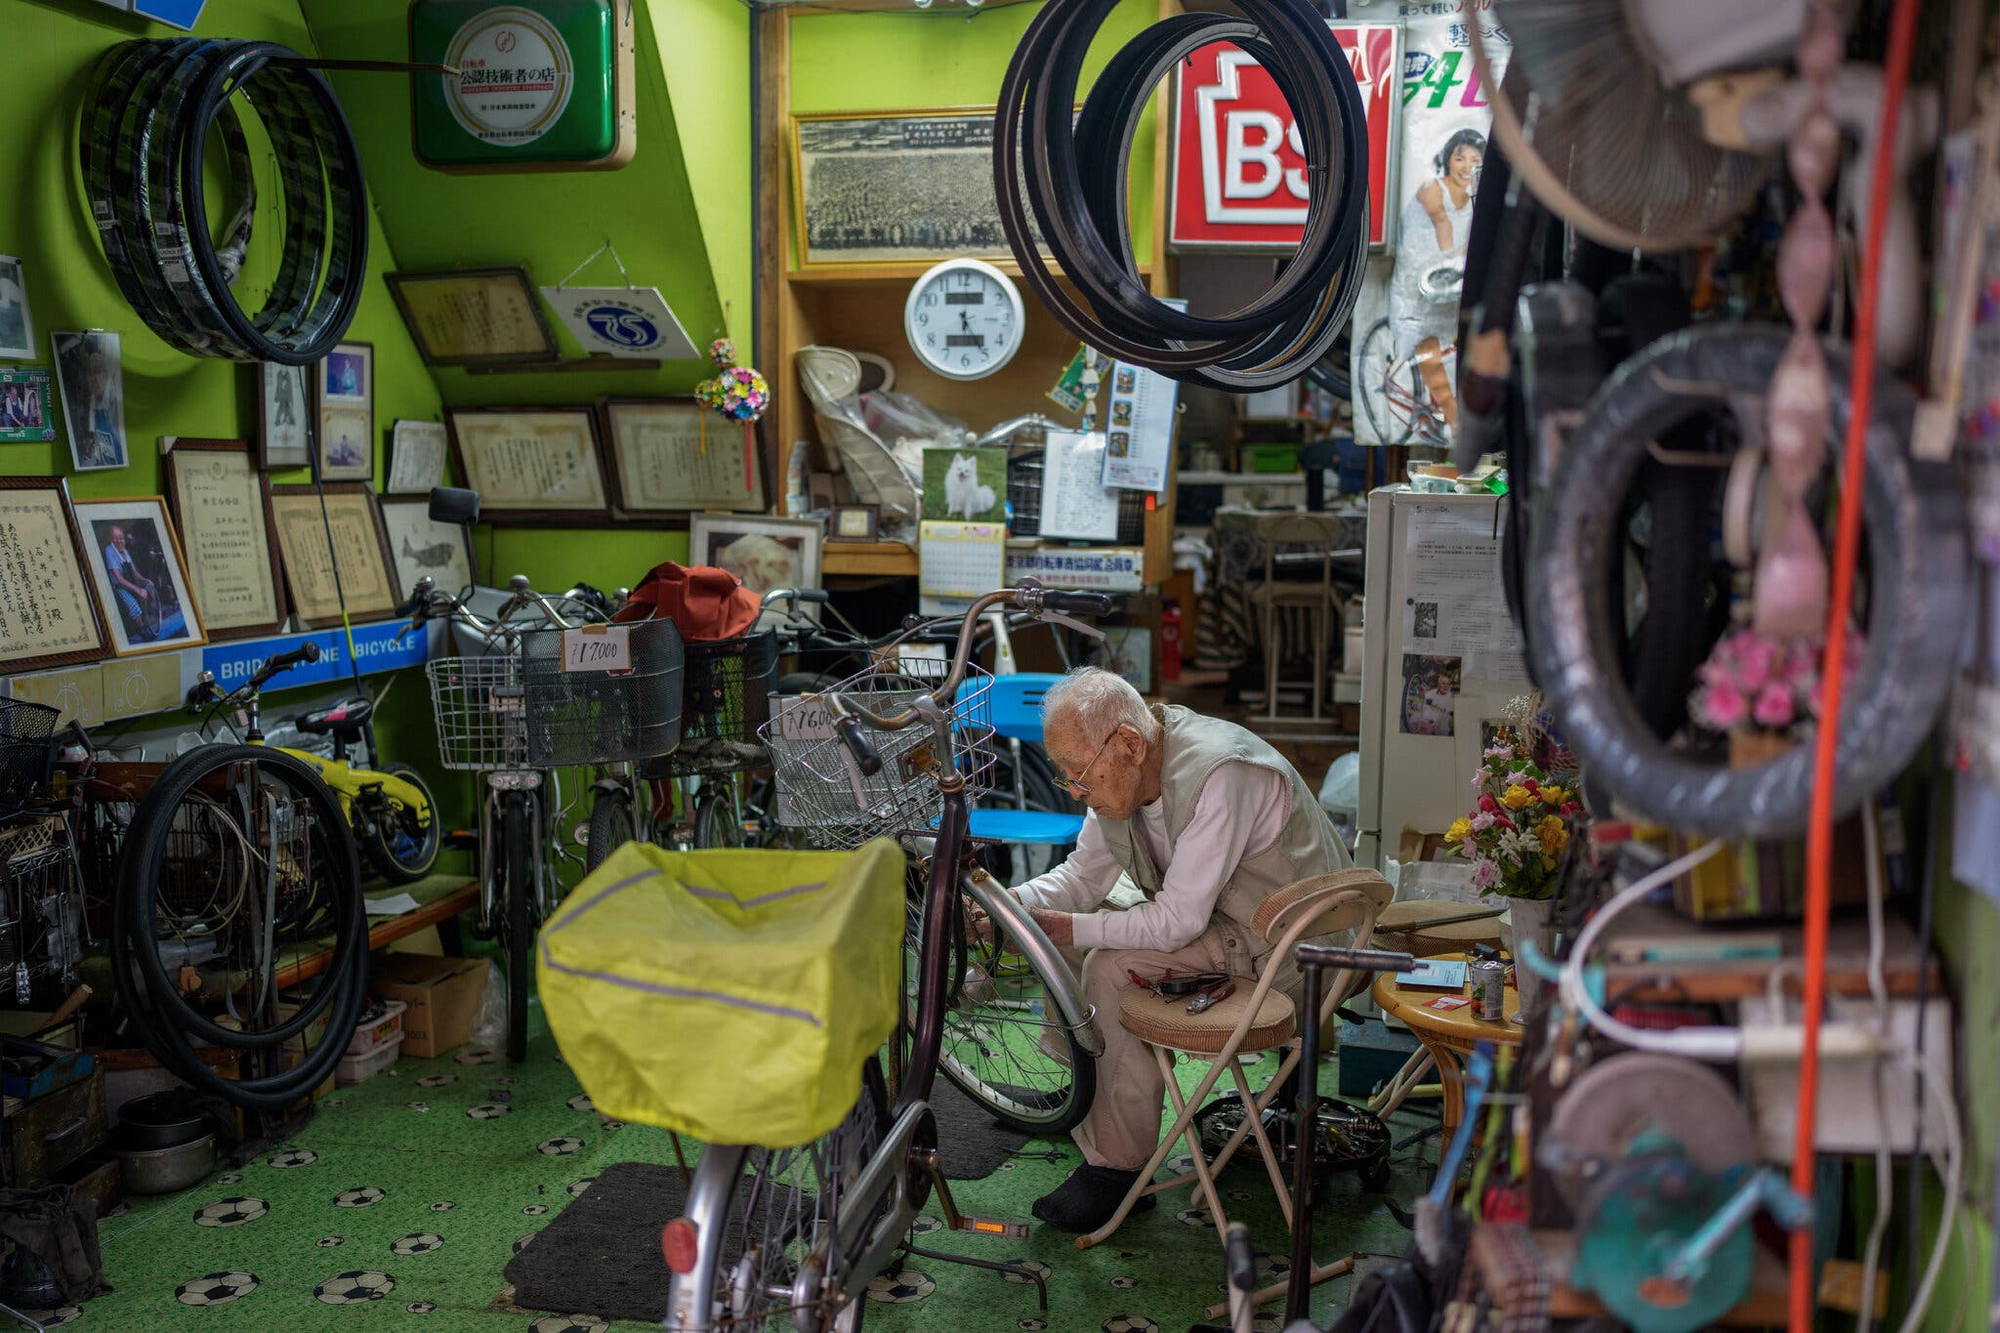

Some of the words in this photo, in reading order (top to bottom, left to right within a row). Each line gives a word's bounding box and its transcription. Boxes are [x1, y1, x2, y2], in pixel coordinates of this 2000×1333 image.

[460, 67, 556, 85] 公認技術者の店
[939, 278, 949, 291] 11
[958, 272, 971, 286] 12
[923, 293, 938, 306] 10
[918, 314, 929, 326] 9
[927, 334, 936, 346] 8
[994, 334, 1004, 346] 4
[942, 348, 951, 361] 7
[960, 353, 971, 367] 6
[979, 349, 989, 362] 5
[221, 646, 340, 680] BRIDNE
[355, 636, 415, 658] BICYCLE
